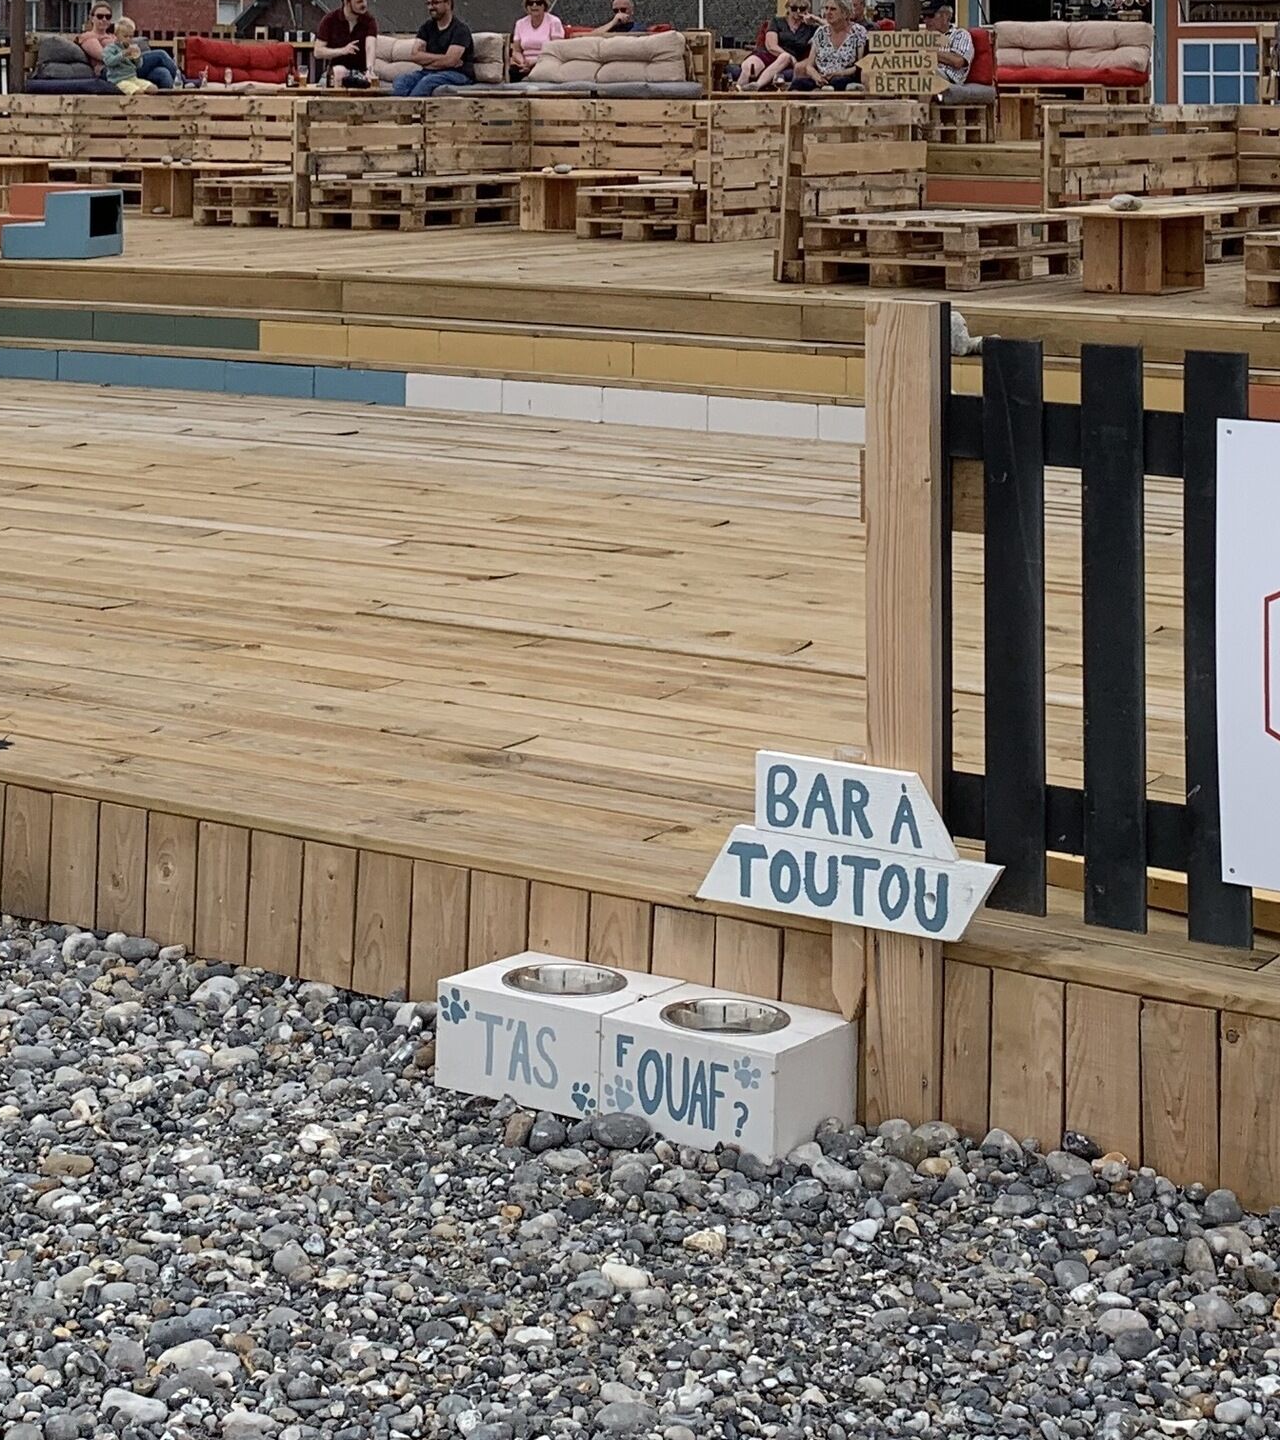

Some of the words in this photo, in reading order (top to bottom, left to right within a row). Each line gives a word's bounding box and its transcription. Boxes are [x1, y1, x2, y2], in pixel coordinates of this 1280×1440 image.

[871, 55, 932, 69] AARHUS
[873, 34, 941, 48] BOUTIQUE
[875, 76, 932, 92] BERLIN
[766, 763, 874, 840] BAR
[890, 783, 923, 849] À
[727, 841, 949, 933] TOUTOU
[475, 1011, 559, 1090] T'AS
